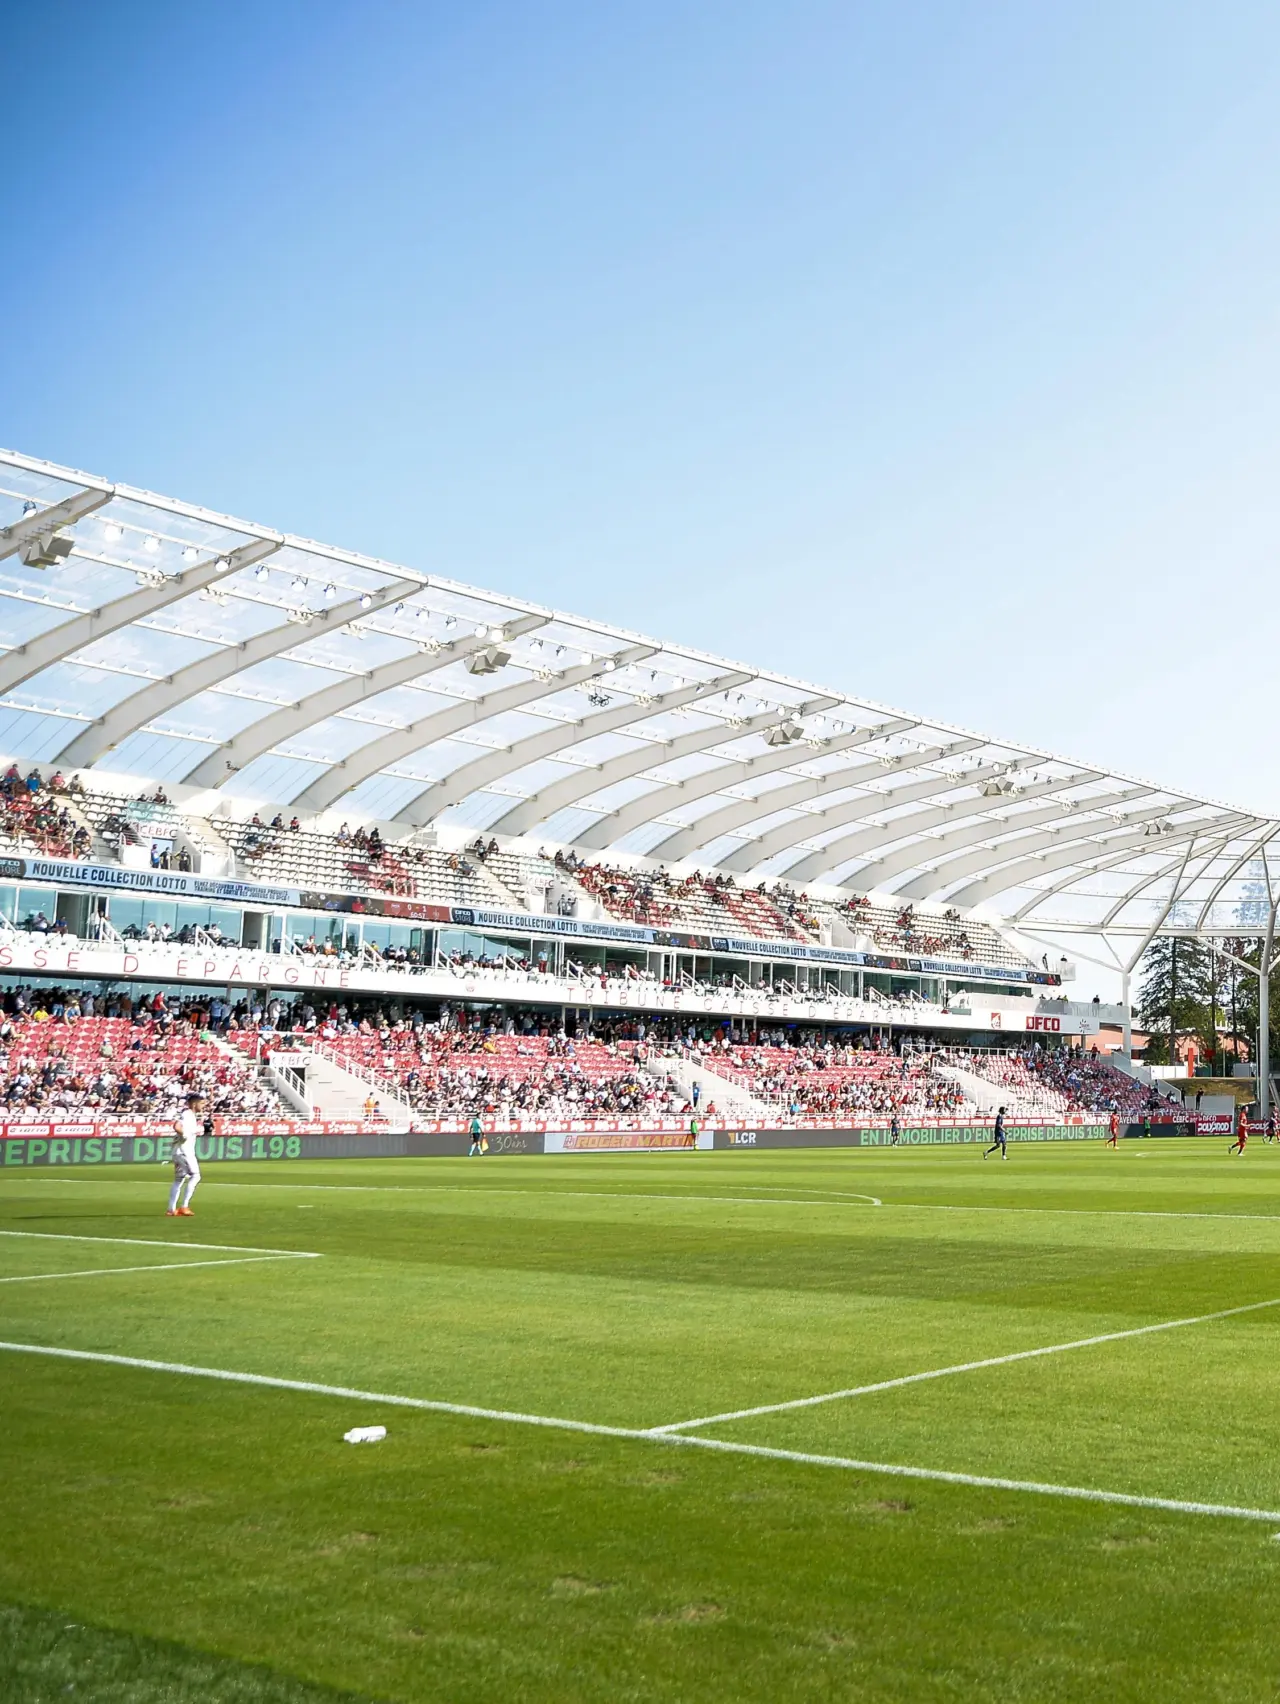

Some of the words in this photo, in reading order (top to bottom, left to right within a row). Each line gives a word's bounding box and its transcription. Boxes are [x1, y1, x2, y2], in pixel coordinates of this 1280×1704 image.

[32, 863, 88, 880] NOUVELLE
[91, 869, 155, 887] COLLECTION
[156, 876, 187, 890] LOTTO
[478, 912, 514, 925] NOUVELLE
[515, 916, 556, 930] COLLECTION
[557, 921, 578, 933] LOTTO
[732, 940, 759, 952] NOUVELLE
[759, 943, 790, 954] COLLECTION
[791, 947, 807, 957] LOTTO
[177, 959, 350, 987] EPARGNE
[924, 961, 944, 971] NOUVELLE
[945, 963, 969, 974] COLLECTION
[970, 966, 982, 975] LOTTO
[567, 987, 681, 1009] TRIBUNE
[704, 998, 788, 1017] CAISSE
[833, 1007, 919, 1025] EPARGNE
[1026, 1016, 1060, 1031] DFCO
[576, 1135, 634, 1149] ROGER
[637, 1133, 695, 1147] MARTIN
[861, 1129, 879, 1146] EN
[884, 1127, 960, 1145] IMOBILIER
[963, 1126, 1045, 1143] D'ENTEPRISE
[1047, 1126, 1084, 1140] DEPUIS
[1087, 1125, 1105, 1139] 198
[0, 1138, 122, 1165] EPRISE
[133, 1136, 243, 1161] DEUIS
[251, 1136, 301, 1160] 198
